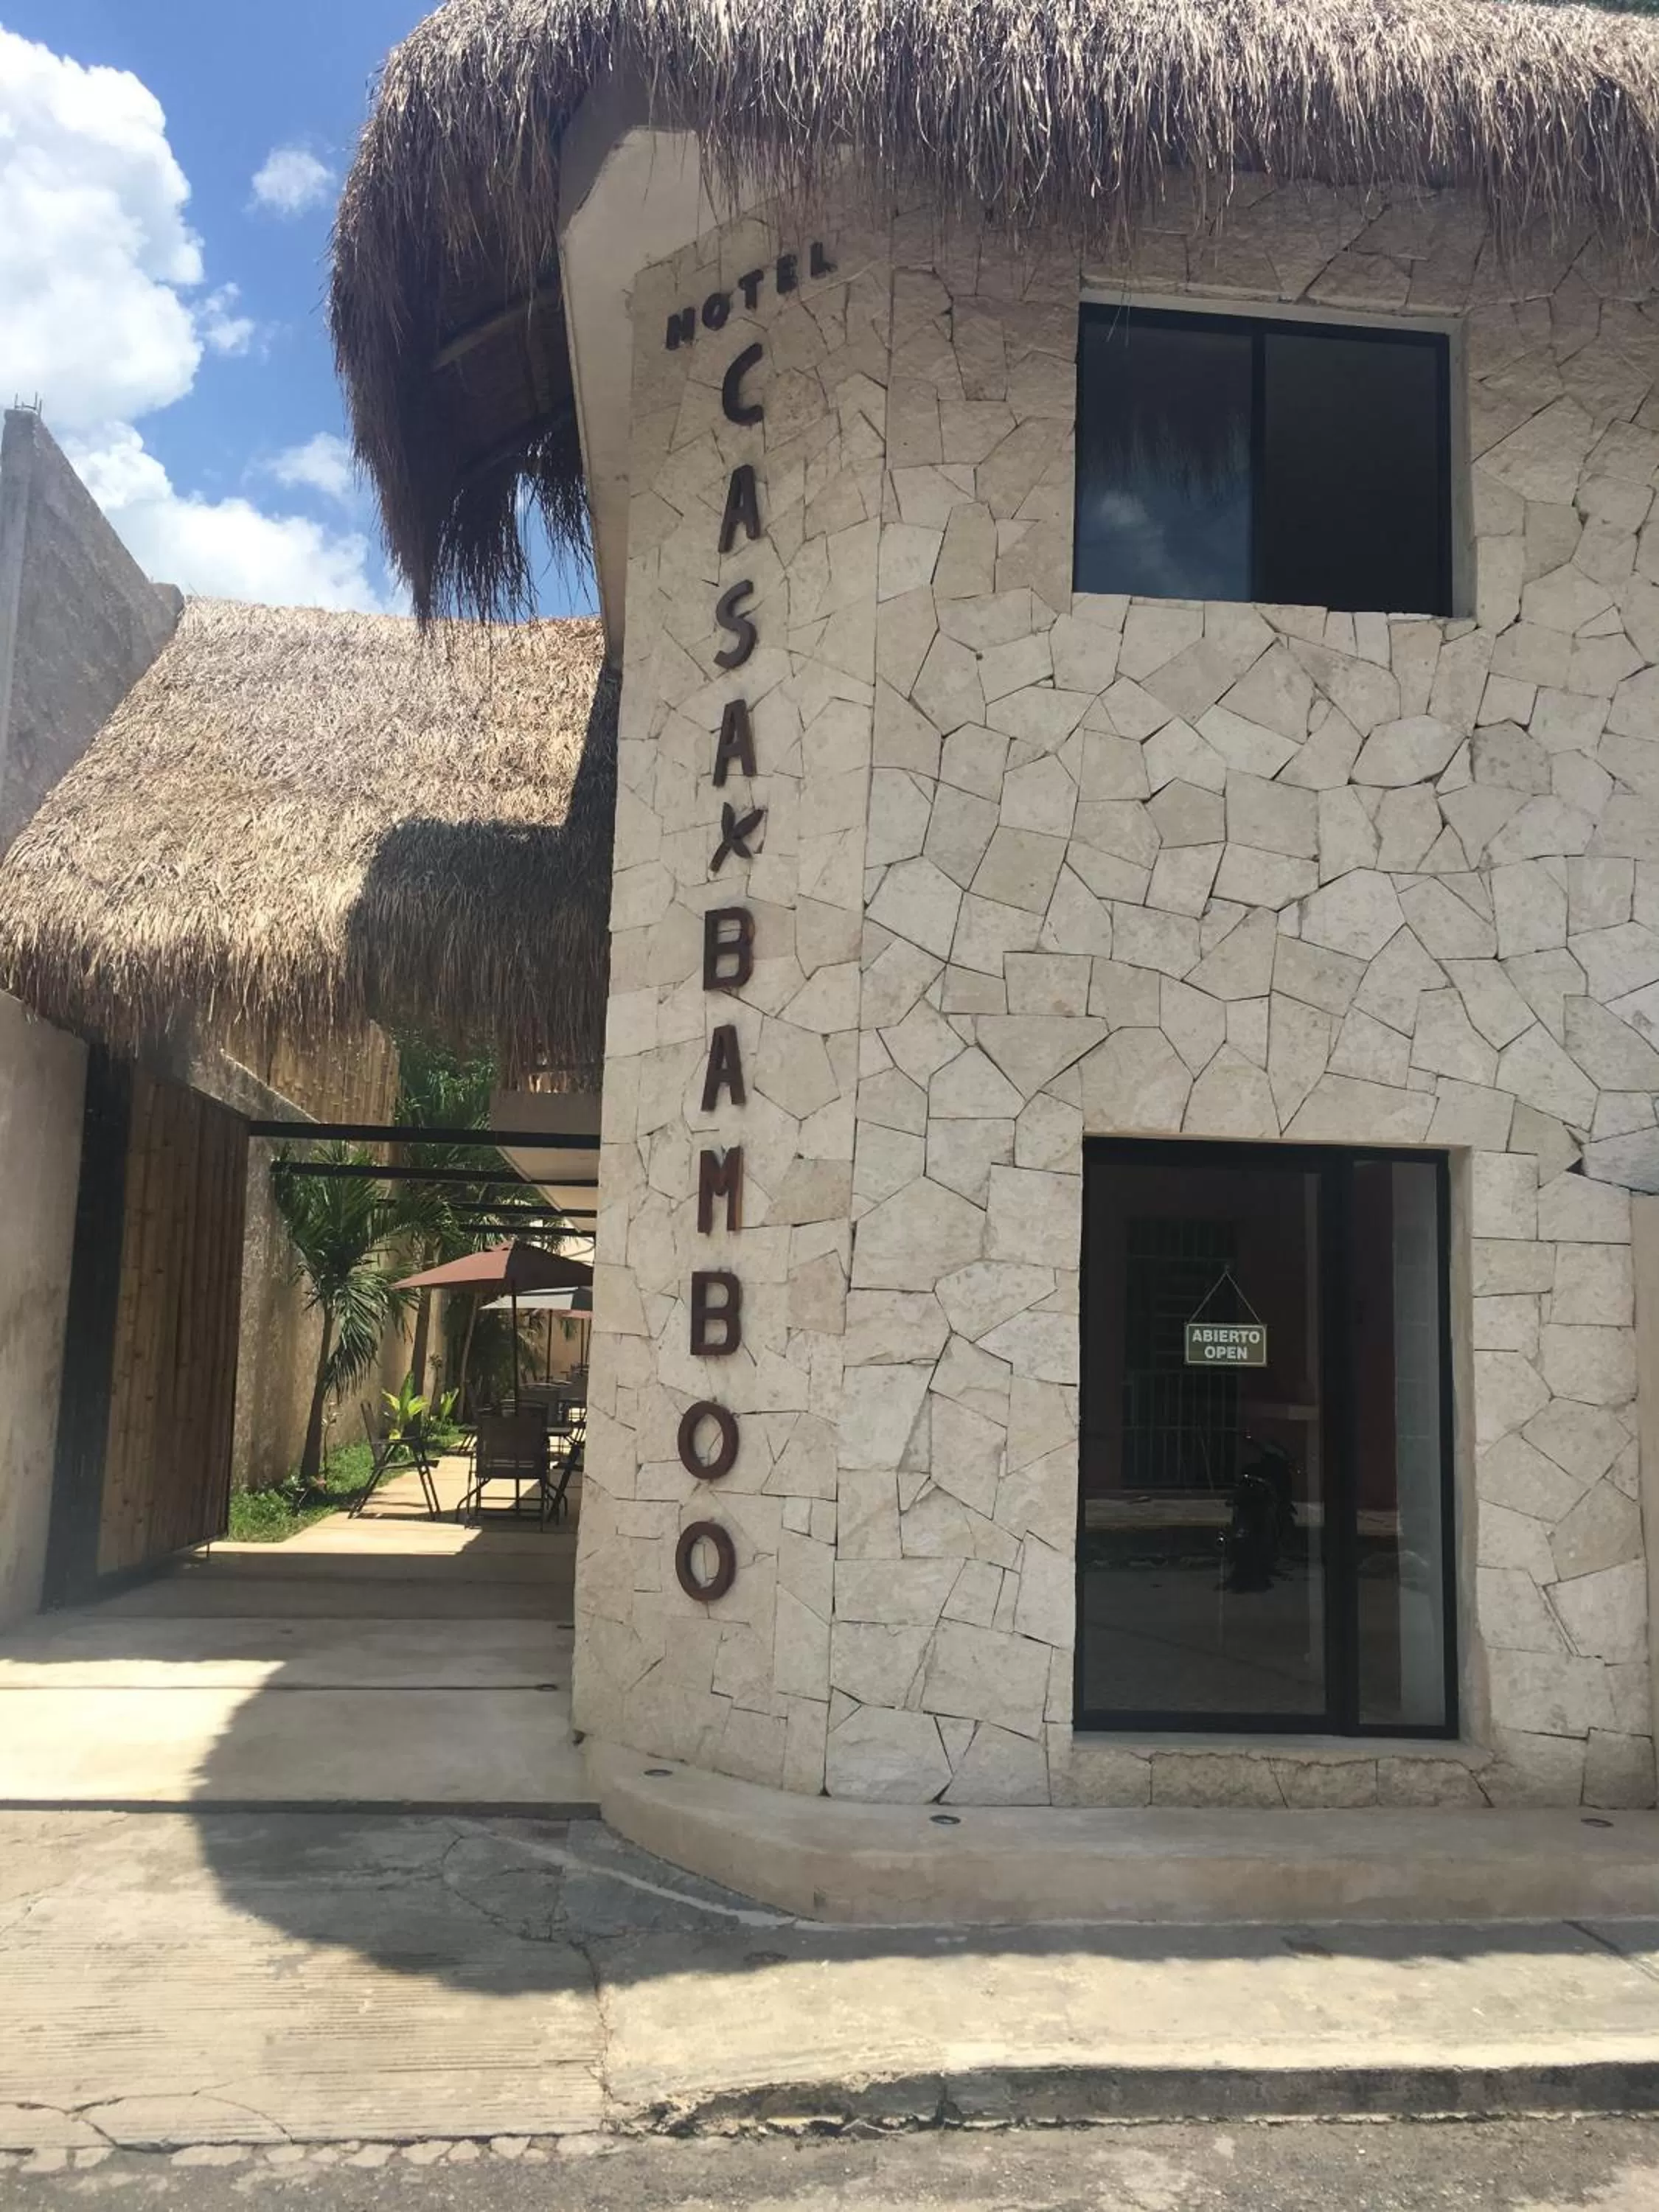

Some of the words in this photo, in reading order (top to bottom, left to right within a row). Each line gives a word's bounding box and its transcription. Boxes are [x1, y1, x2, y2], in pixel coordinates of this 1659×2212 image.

[666, 241, 838, 351] HOTEL
[1192, 1329, 1261, 1343] ABIERTO
[1204, 1346, 1248, 1360] OPEN
